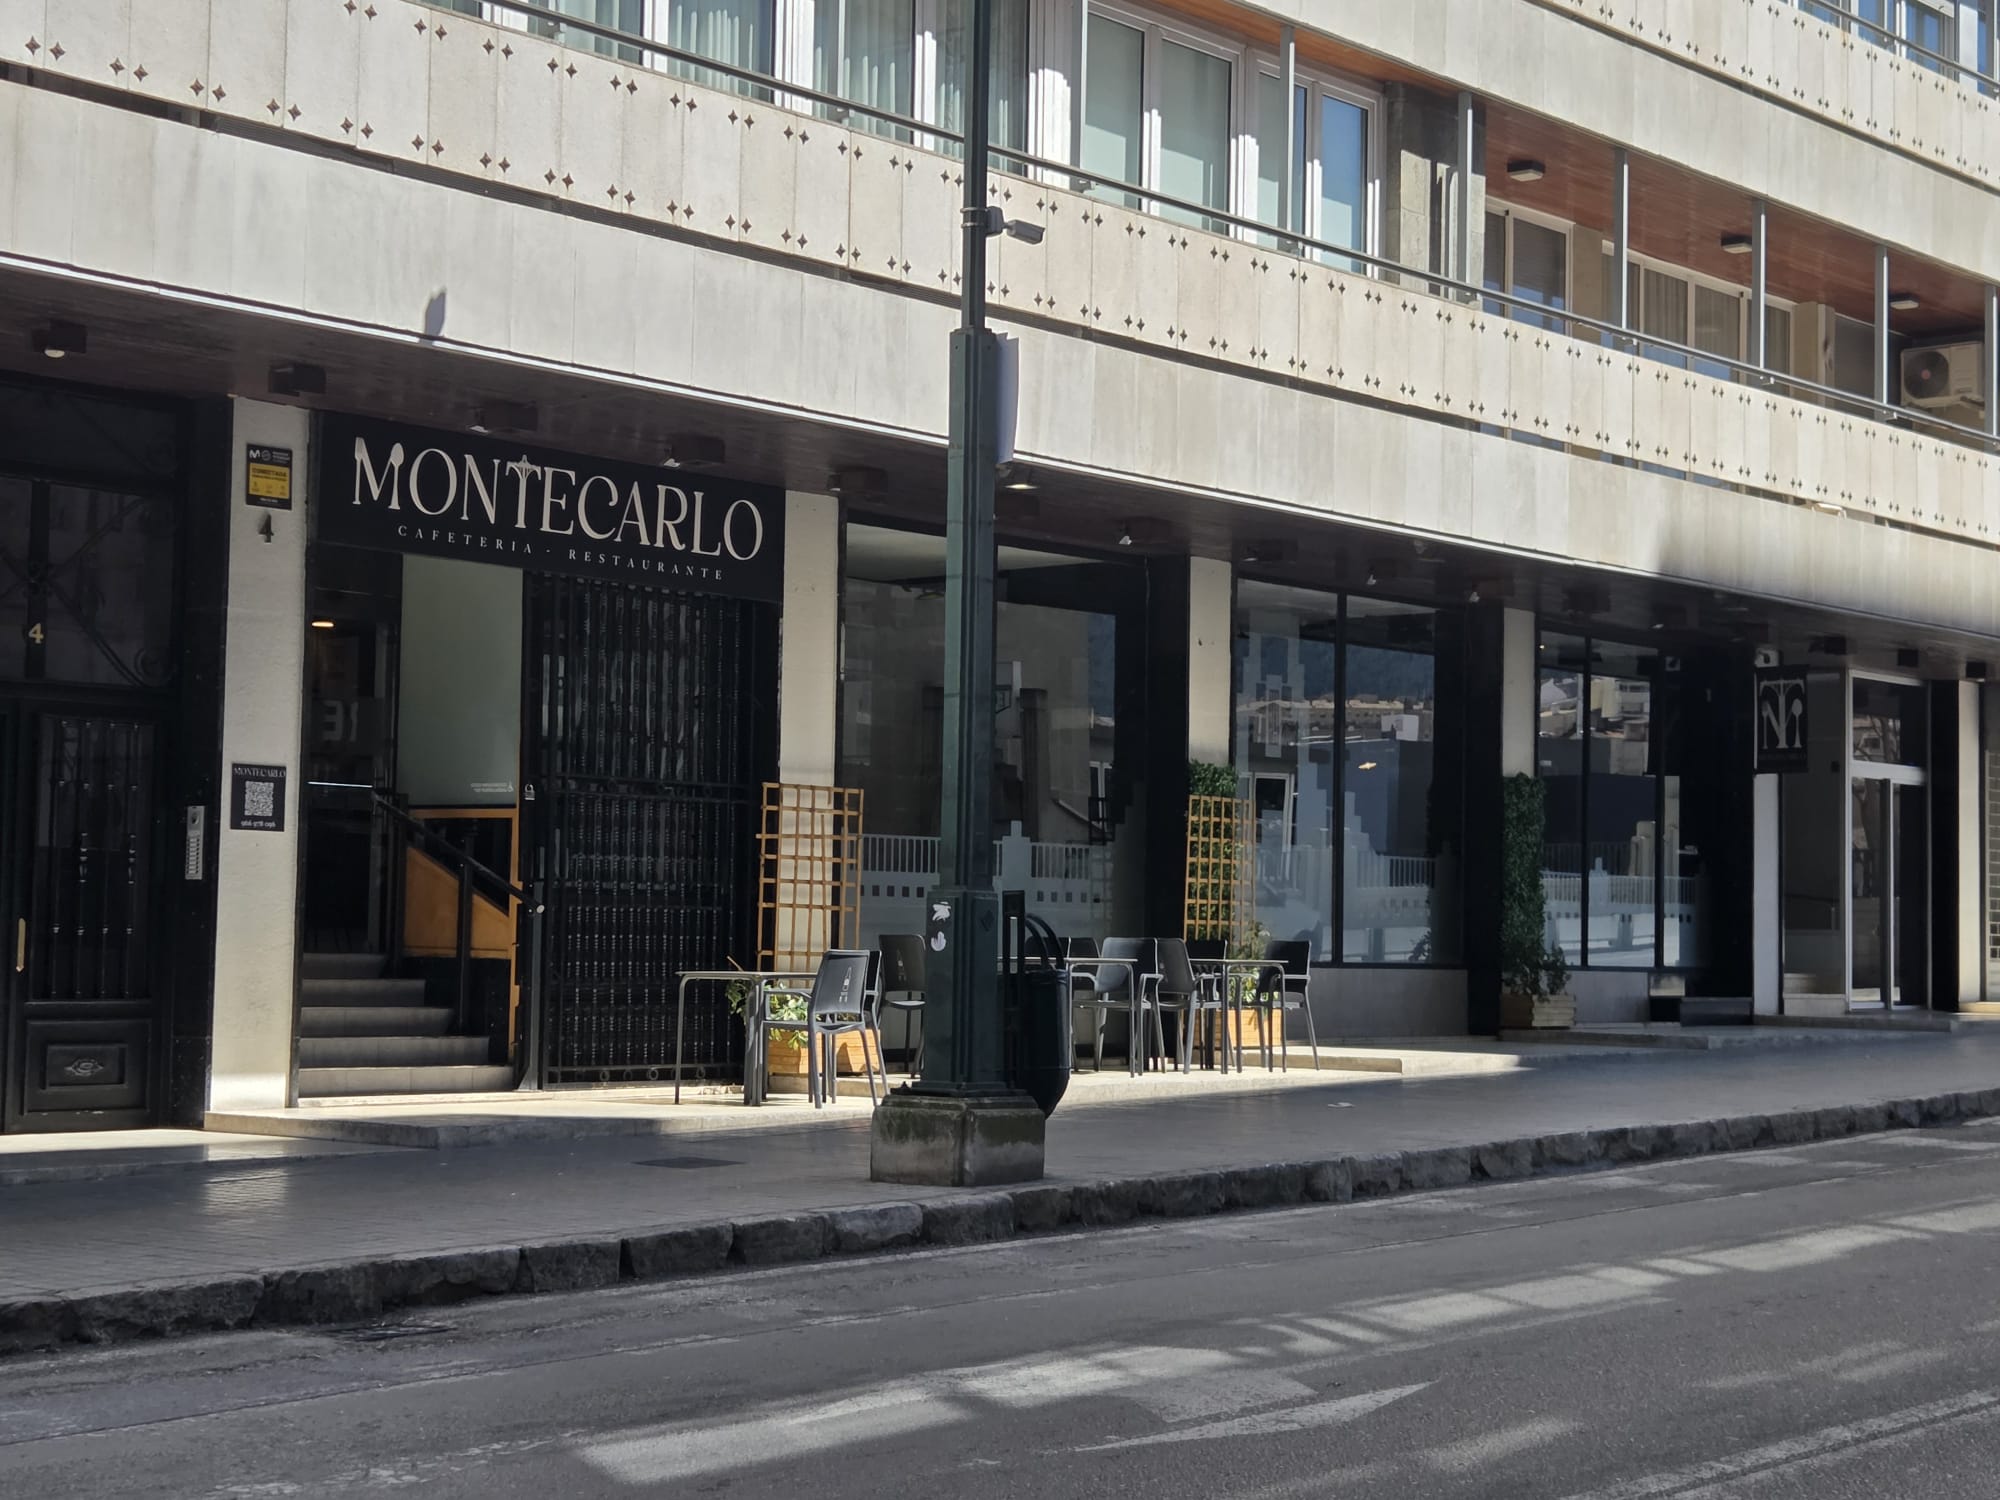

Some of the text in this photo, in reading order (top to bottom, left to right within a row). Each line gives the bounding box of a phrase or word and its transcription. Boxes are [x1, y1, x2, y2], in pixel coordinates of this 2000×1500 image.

[352, 436, 764, 561] MONTECARLO
[258, 512, 274, 543] 4
[397, 525, 532, 554] CAFETERIA
[568, 548, 724, 581] RESTAURANTE
[28, 622, 44, 644] 4
